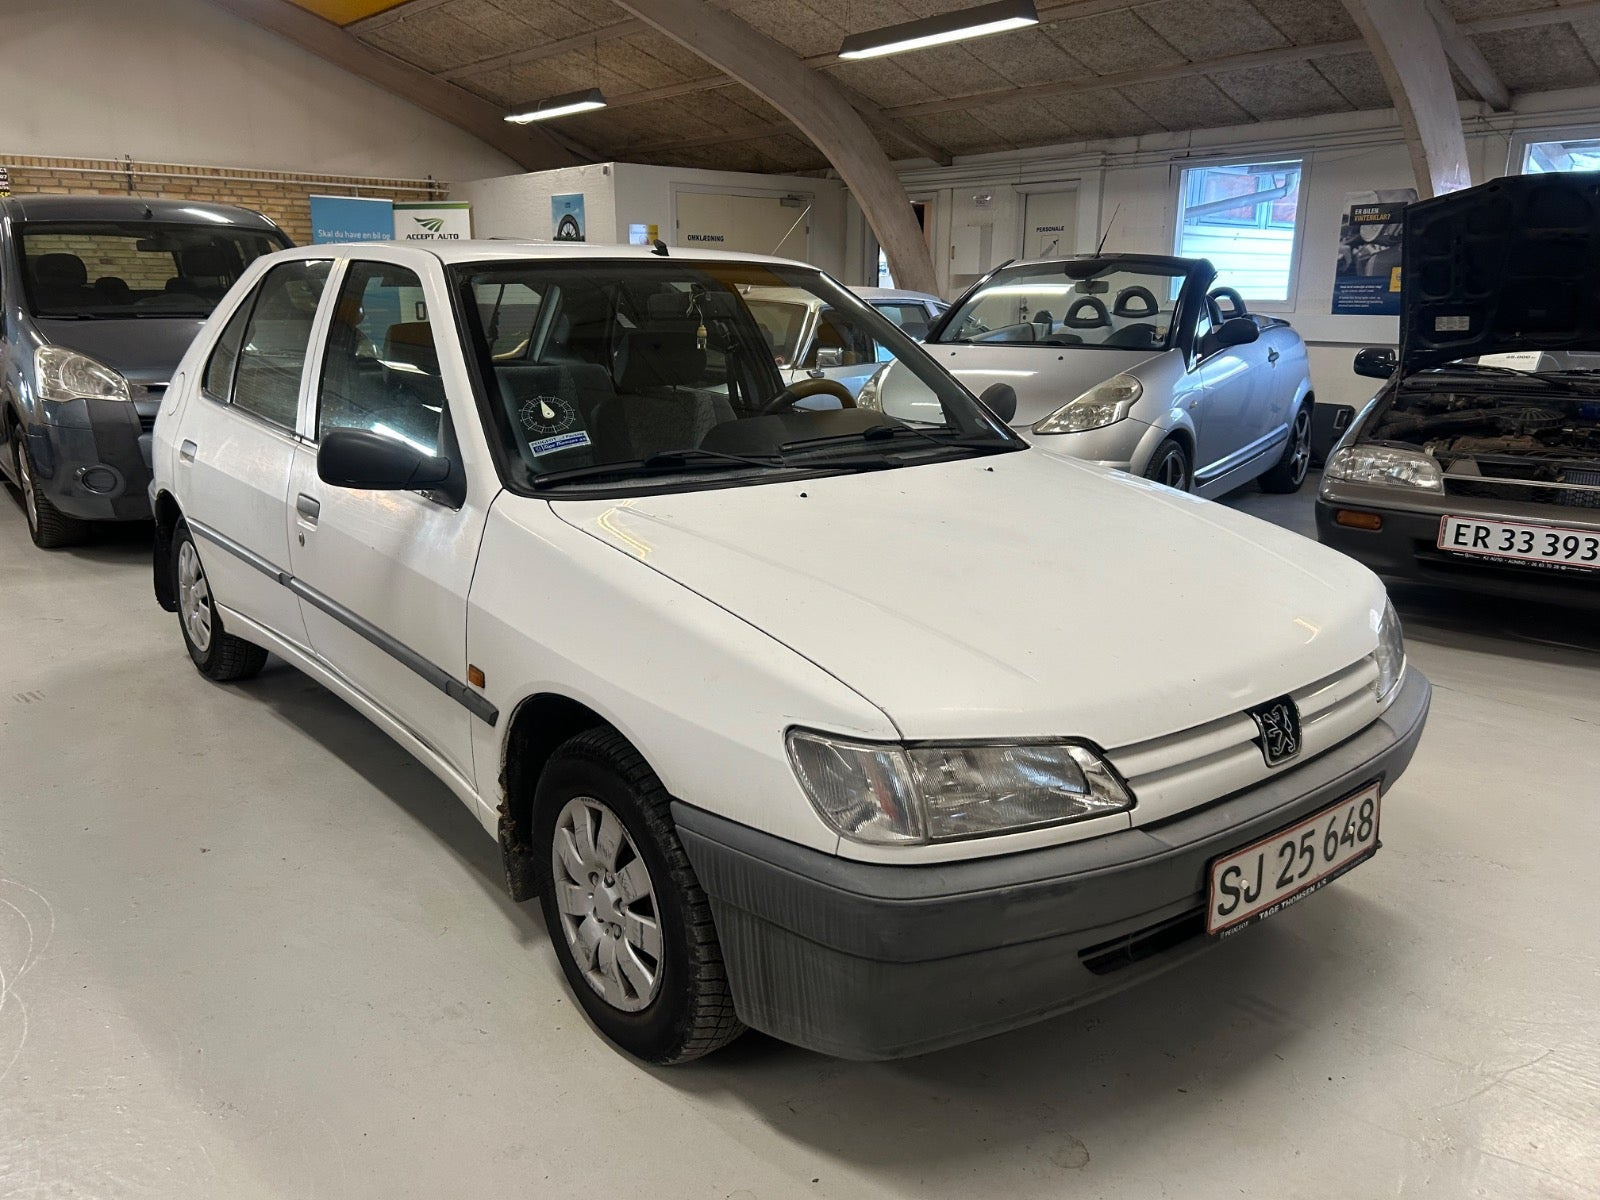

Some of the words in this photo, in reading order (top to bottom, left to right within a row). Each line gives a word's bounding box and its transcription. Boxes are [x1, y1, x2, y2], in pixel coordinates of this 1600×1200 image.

[318, 229, 333, 237] Skal
[687, 234, 724, 242] OMKLÆDNING
[1453, 523, 1491, 549] ER
[1498, 529, 1535, 554] 33
[1542, 533, 1599, 561] 393
[1218, 853, 1264, 916] SJ
[1276, 829, 1315, 889] 25
[1324, 798, 1374, 861] 648
[1258, 905, 1281, 920] TAGE
[1281, 887, 1317, 909] THOMSEN
[1316, 878, 1327, 890] A/S
